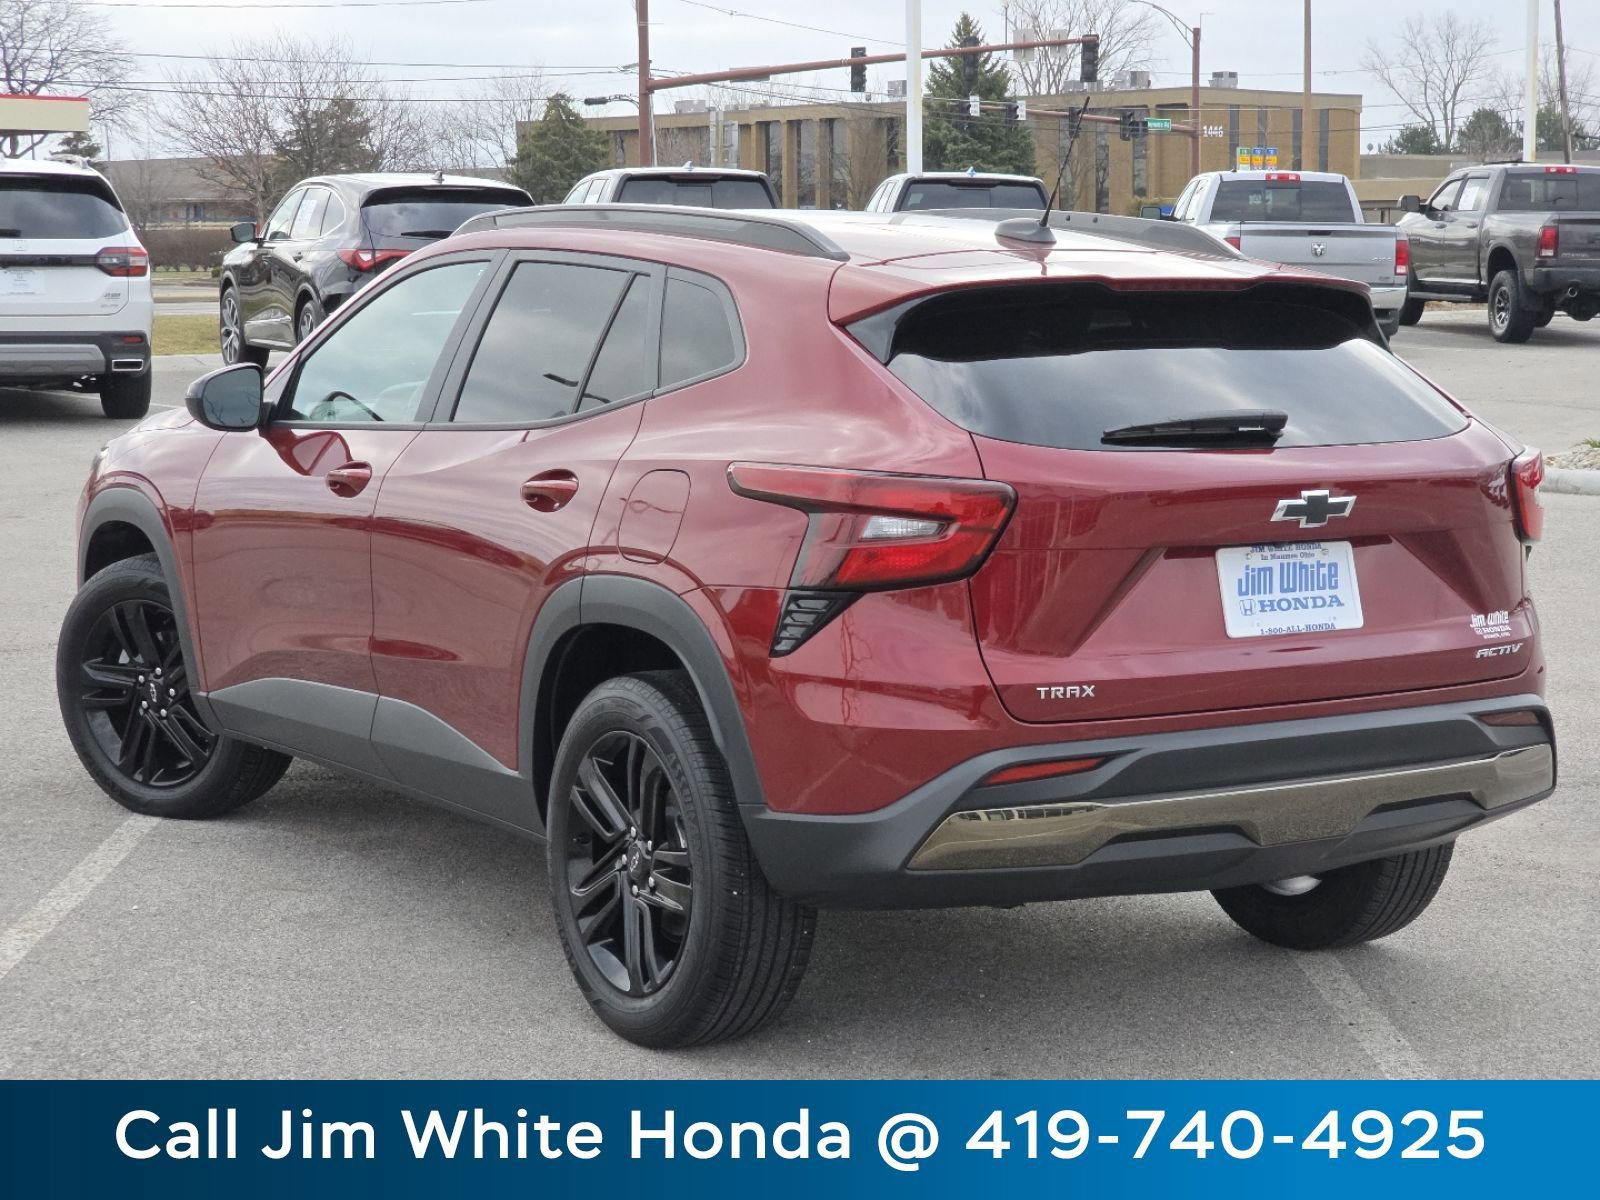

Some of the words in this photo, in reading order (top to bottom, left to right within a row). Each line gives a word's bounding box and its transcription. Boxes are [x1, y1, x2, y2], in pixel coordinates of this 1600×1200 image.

[1202, 124, 1224, 138] 1446
[1237, 564, 1273, 597] Jim
[1279, 559, 1339, 594] White
[1258, 594, 1345, 613] HONDA
[1475, 642, 1523, 659] ACTIV
[1036, 684, 1096, 700] TRAX
